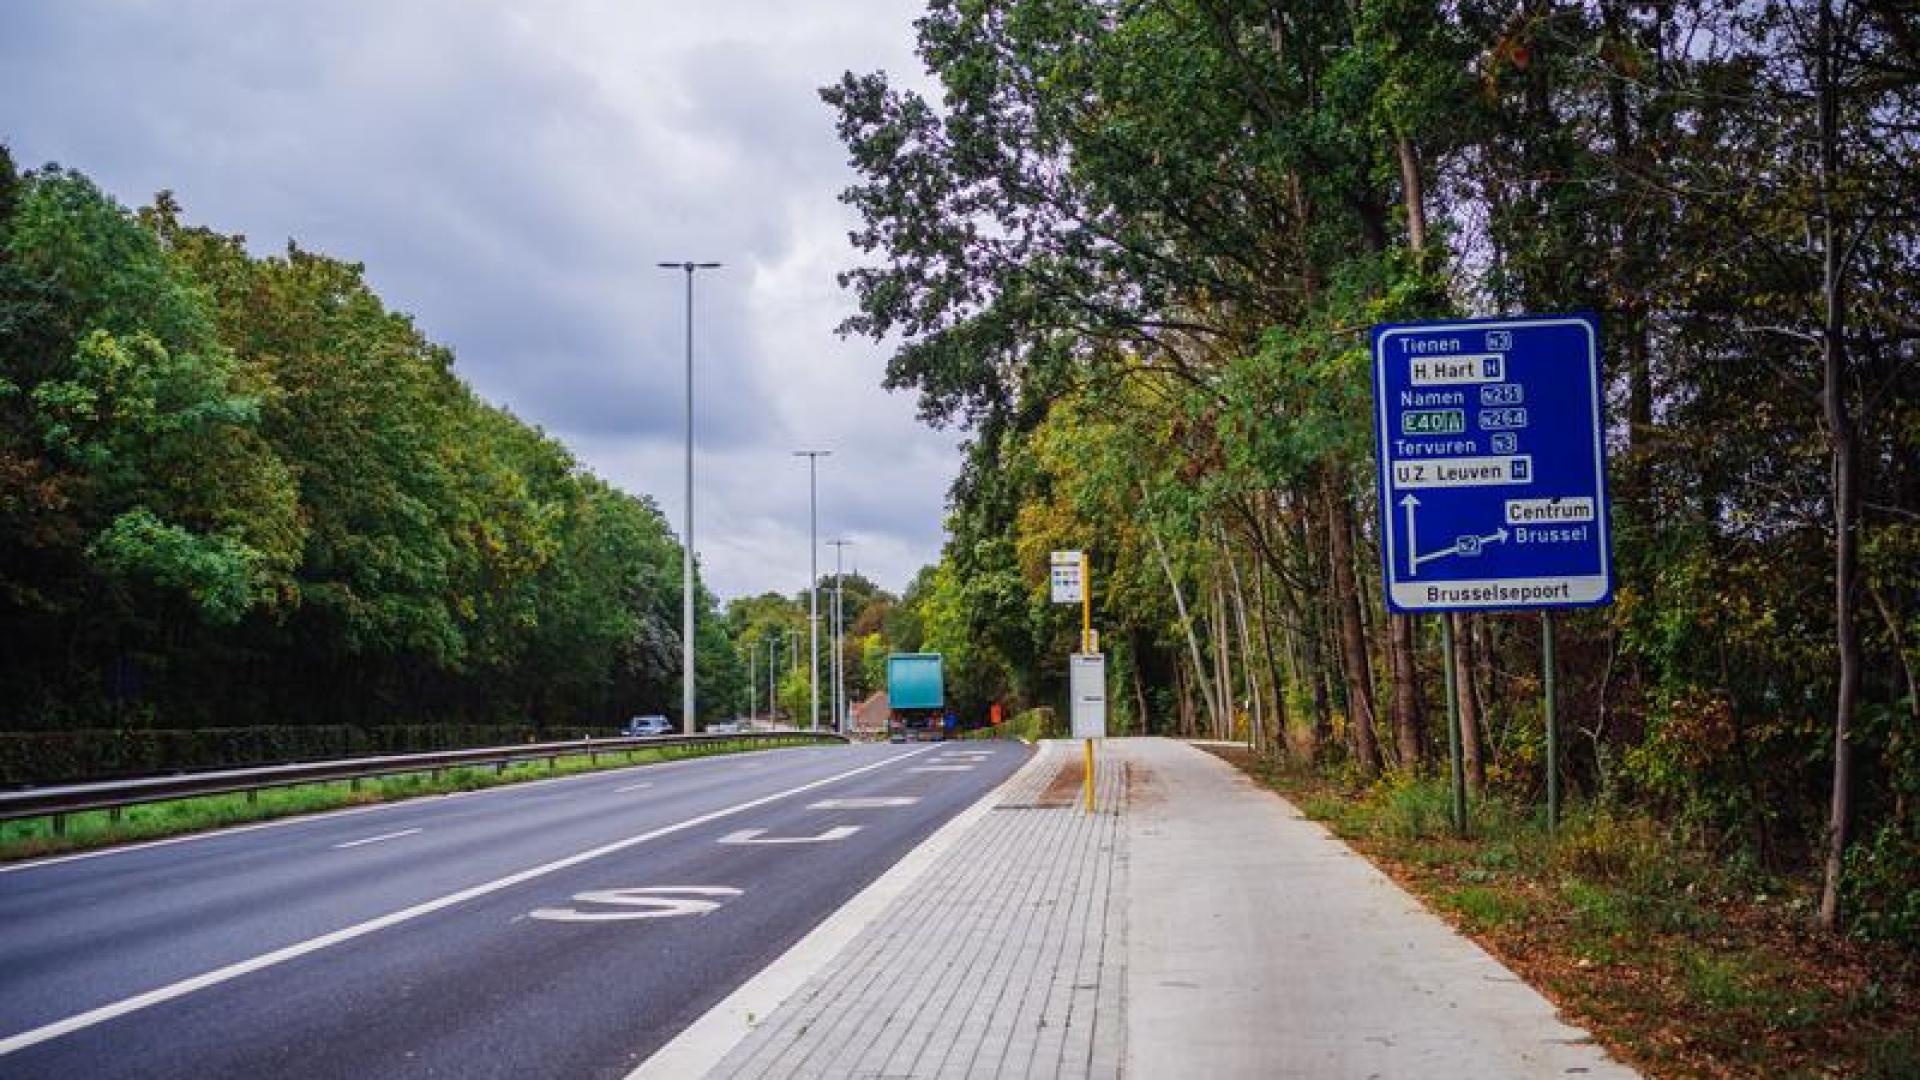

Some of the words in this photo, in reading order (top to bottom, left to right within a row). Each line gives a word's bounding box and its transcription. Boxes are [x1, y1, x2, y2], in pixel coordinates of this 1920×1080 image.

[1399, 336, 1460, 354] Tienen
[1401, 390, 1465, 407] Namen
[1404, 412, 1442, 431] E40
[1395, 438, 1477, 456] Tervuren
[1437, 464, 1502, 481] Leuven
[1509, 502, 1590, 521] Centrum
[1516, 525, 1588, 544] Brussel
[1427, 582, 1570, 603] Brusselsepoort
